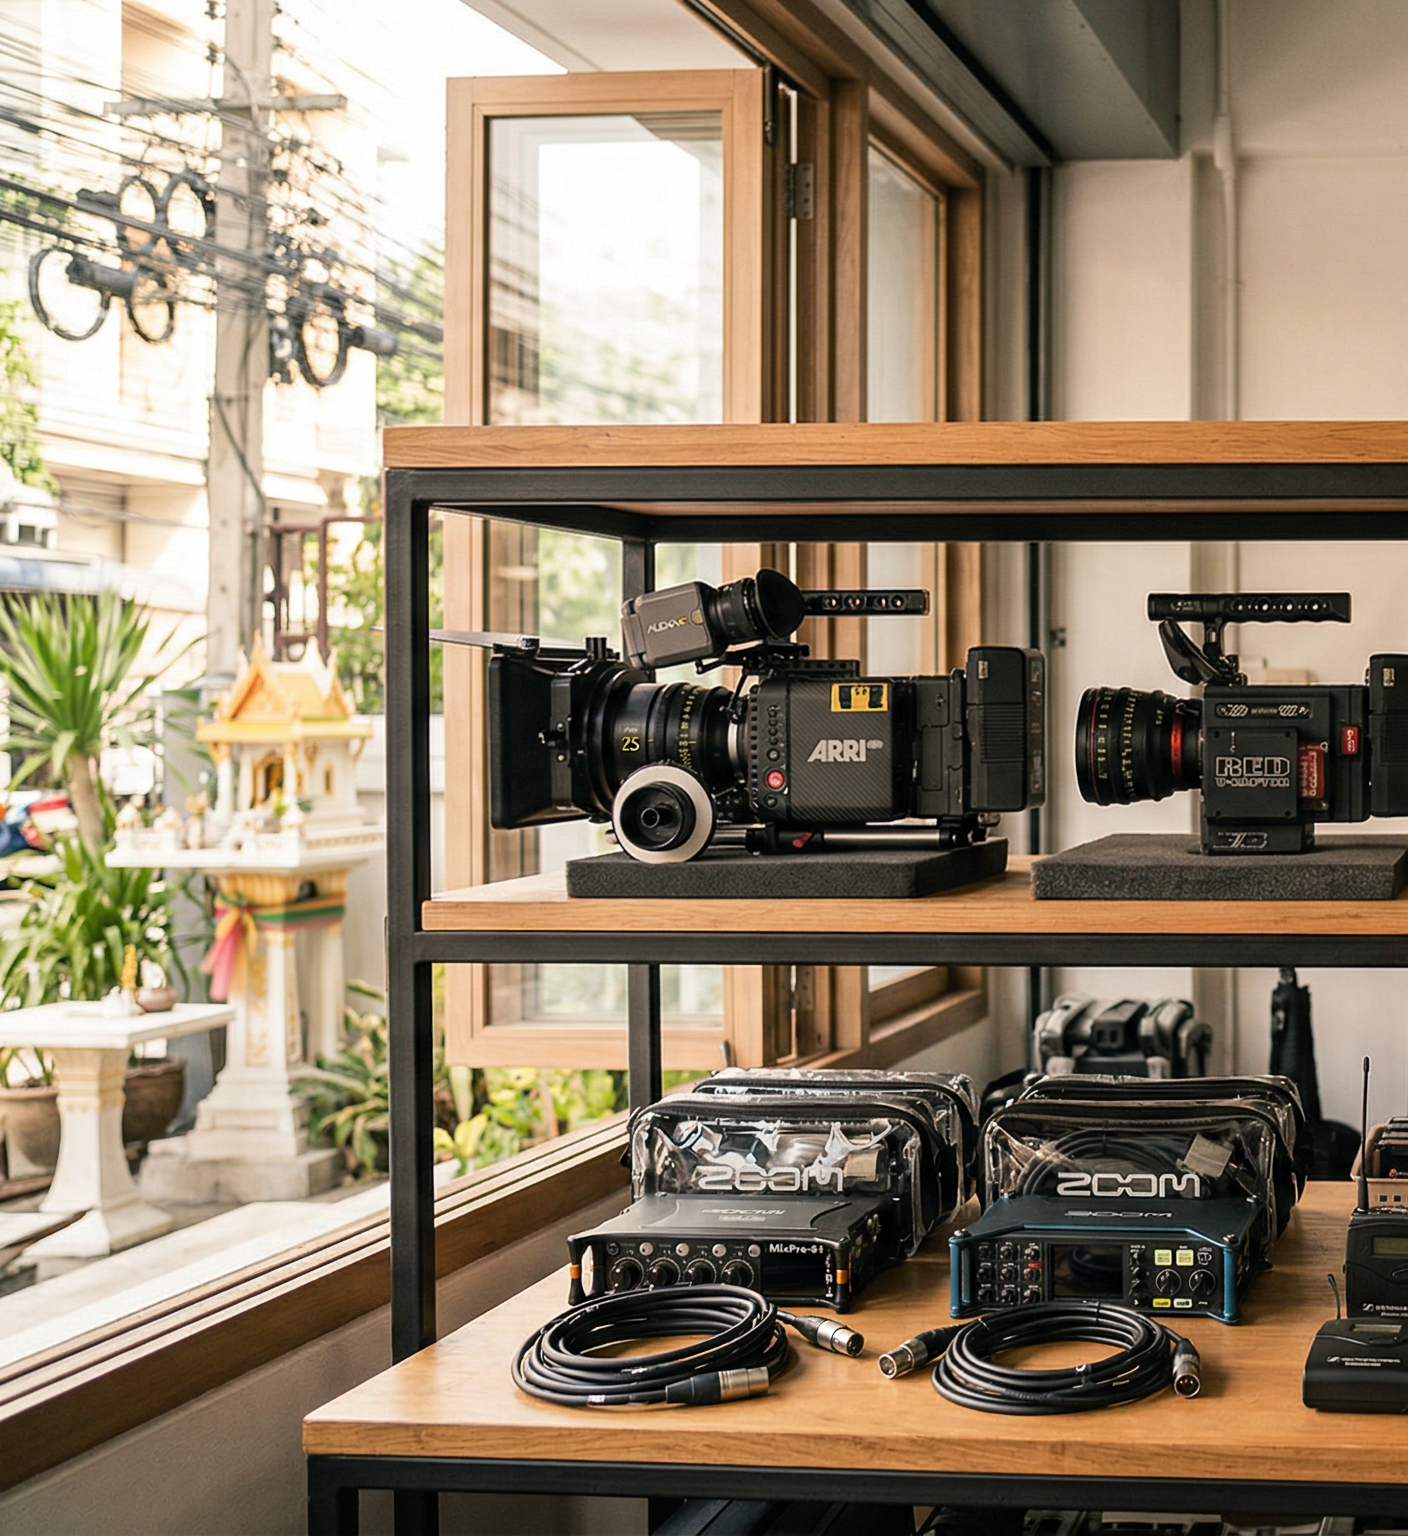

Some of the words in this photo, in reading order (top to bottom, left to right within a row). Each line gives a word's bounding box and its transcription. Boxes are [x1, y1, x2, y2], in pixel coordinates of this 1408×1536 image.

[622, 736, 640, 751] 25
[807, 739, 867, 762] ARRI
[1215, 757, 1290, 776] RED
[697, 1165, 843, 1192] ZOOM
[1056, 1172, 1200, 1198] ZOOM
